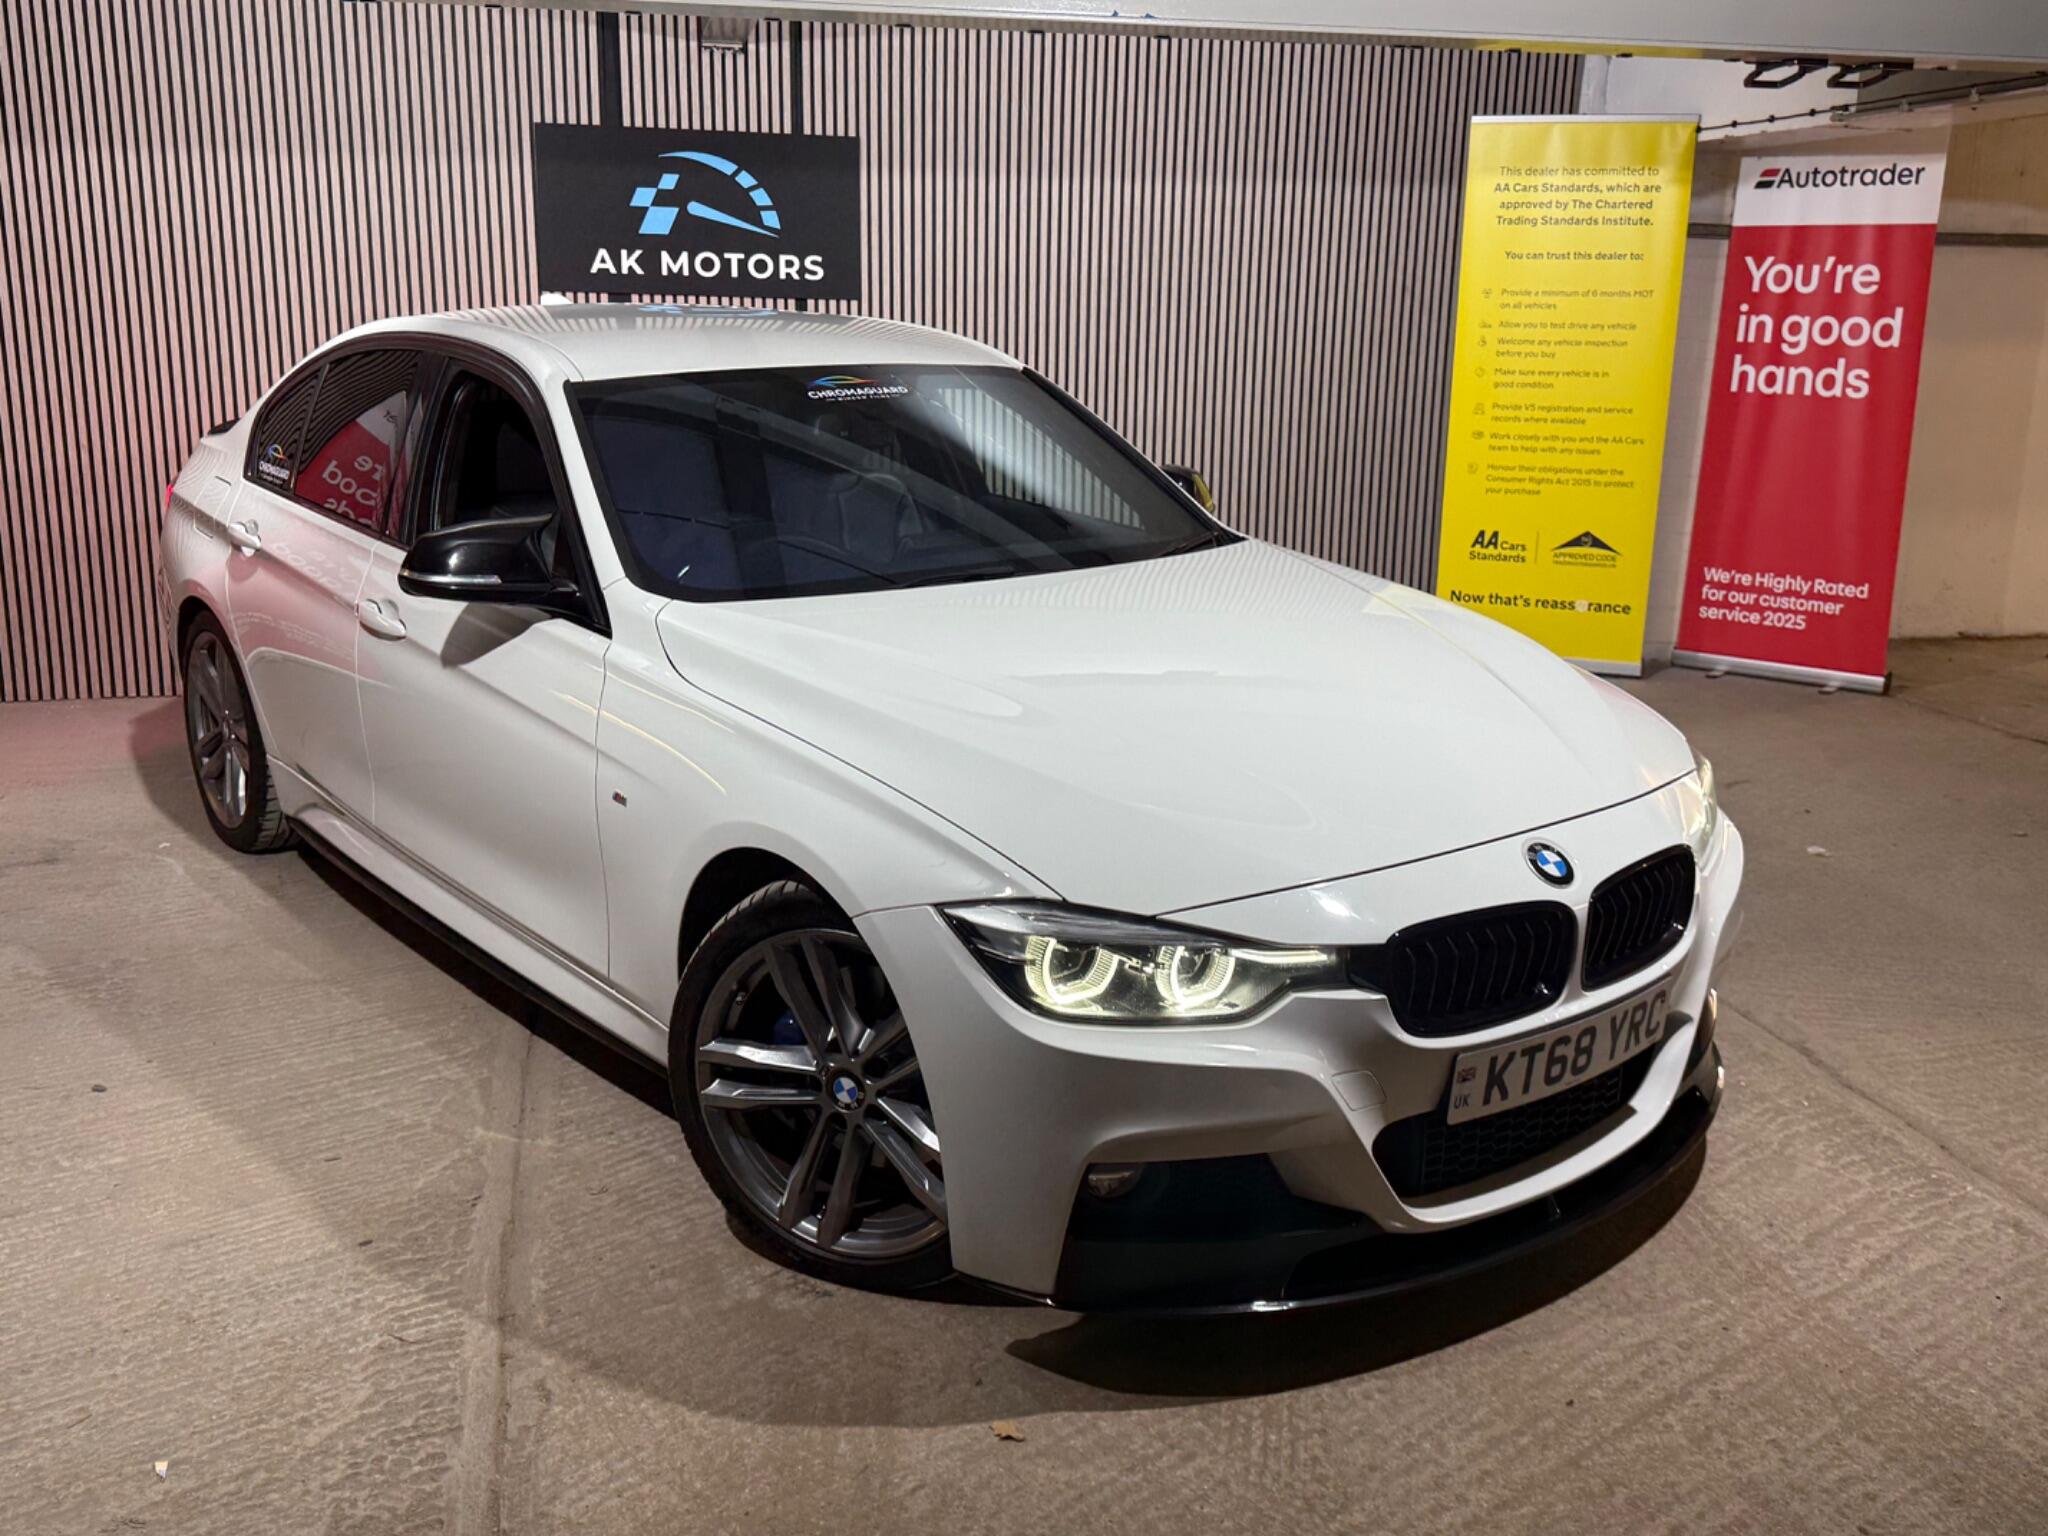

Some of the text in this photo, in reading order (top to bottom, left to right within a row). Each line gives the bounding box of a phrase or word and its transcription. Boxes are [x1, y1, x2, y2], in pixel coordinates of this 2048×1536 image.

[1500, 166, 1659, 177] This dealer has committed to
[1776, 163, 1925, 189] Autotrader
[1494, 183, 1662, 195] AA Cars Standards, which are
[1499, 200, 1653, 211] approved by The Chartered
[1496, 216, 1654, 227] Trading Standards Institute.
[1505, 251, 1644, 262] You can trust this dealer to:
[590, 248, 825, 281] AK MOTORS
[1744, 256, 1881, 295] You're
[1541, 289, 1579, 298] minimum
[1600, 289, 1632, 298] months
[1633, 289, 1655, 298] MOT
[1523, 323, 1538, 331] you
[1590, 323, 1605, 332] any
[1607, 322, 1637, 331] vehicle
[1736, 303, 1904, 355] in good
[1497, 338, 1628, 349] Welcome any vehicle inspection
[1523, 352, 1539, 360] you
[1541, 351, 1556, 360] buy
[1494, 367, 1516, 376] Make
[1537, 370, 1560, 379] every
[1561, 369, 1591, 378] vehicle
[1730, 353, 1870, 399] hands
[1493, 380, 1554, 389] good condition
[807, 386, 909, 399] CHROMAGUARD
[1537, 404, 1584, 414] registration
[1586, 405, 1602, 414] and
[1603, 406, 1633, 415] service
[1491, 415, 1522, 424] records
[1550, 416, 1587, 425] available
[1512, 433, 1540, 443] closely
[1562, 436, 1577, 444] you
[1579, 435, 1594, 444] and
[1624, 437, 1645, 446] Cars
[1559, 447, 1574, 456] any
[1585, 467, 1608, 475] under
[1610, 468, 1624, 476] the
[1486, 474, 1527, 483] Consumer
[1555, 477, 1570, 486] Act
[1471, 530, 1527, 551] AA Cars
[1469, 551, 1526, 563] Standards
[1703, 566, 1870, 599] We're Highly Rated
[1450, 589, 1485, 604] Now
[1535, 598, 1632, 615] reassrance
[1701, 584, 1844, 616] for our customer
[1698, 605, 1807, 630] service 2025
[1482, 990, 1667, 1106] KT68 YRC
[1454, 1093, 1471, 1110] UK
